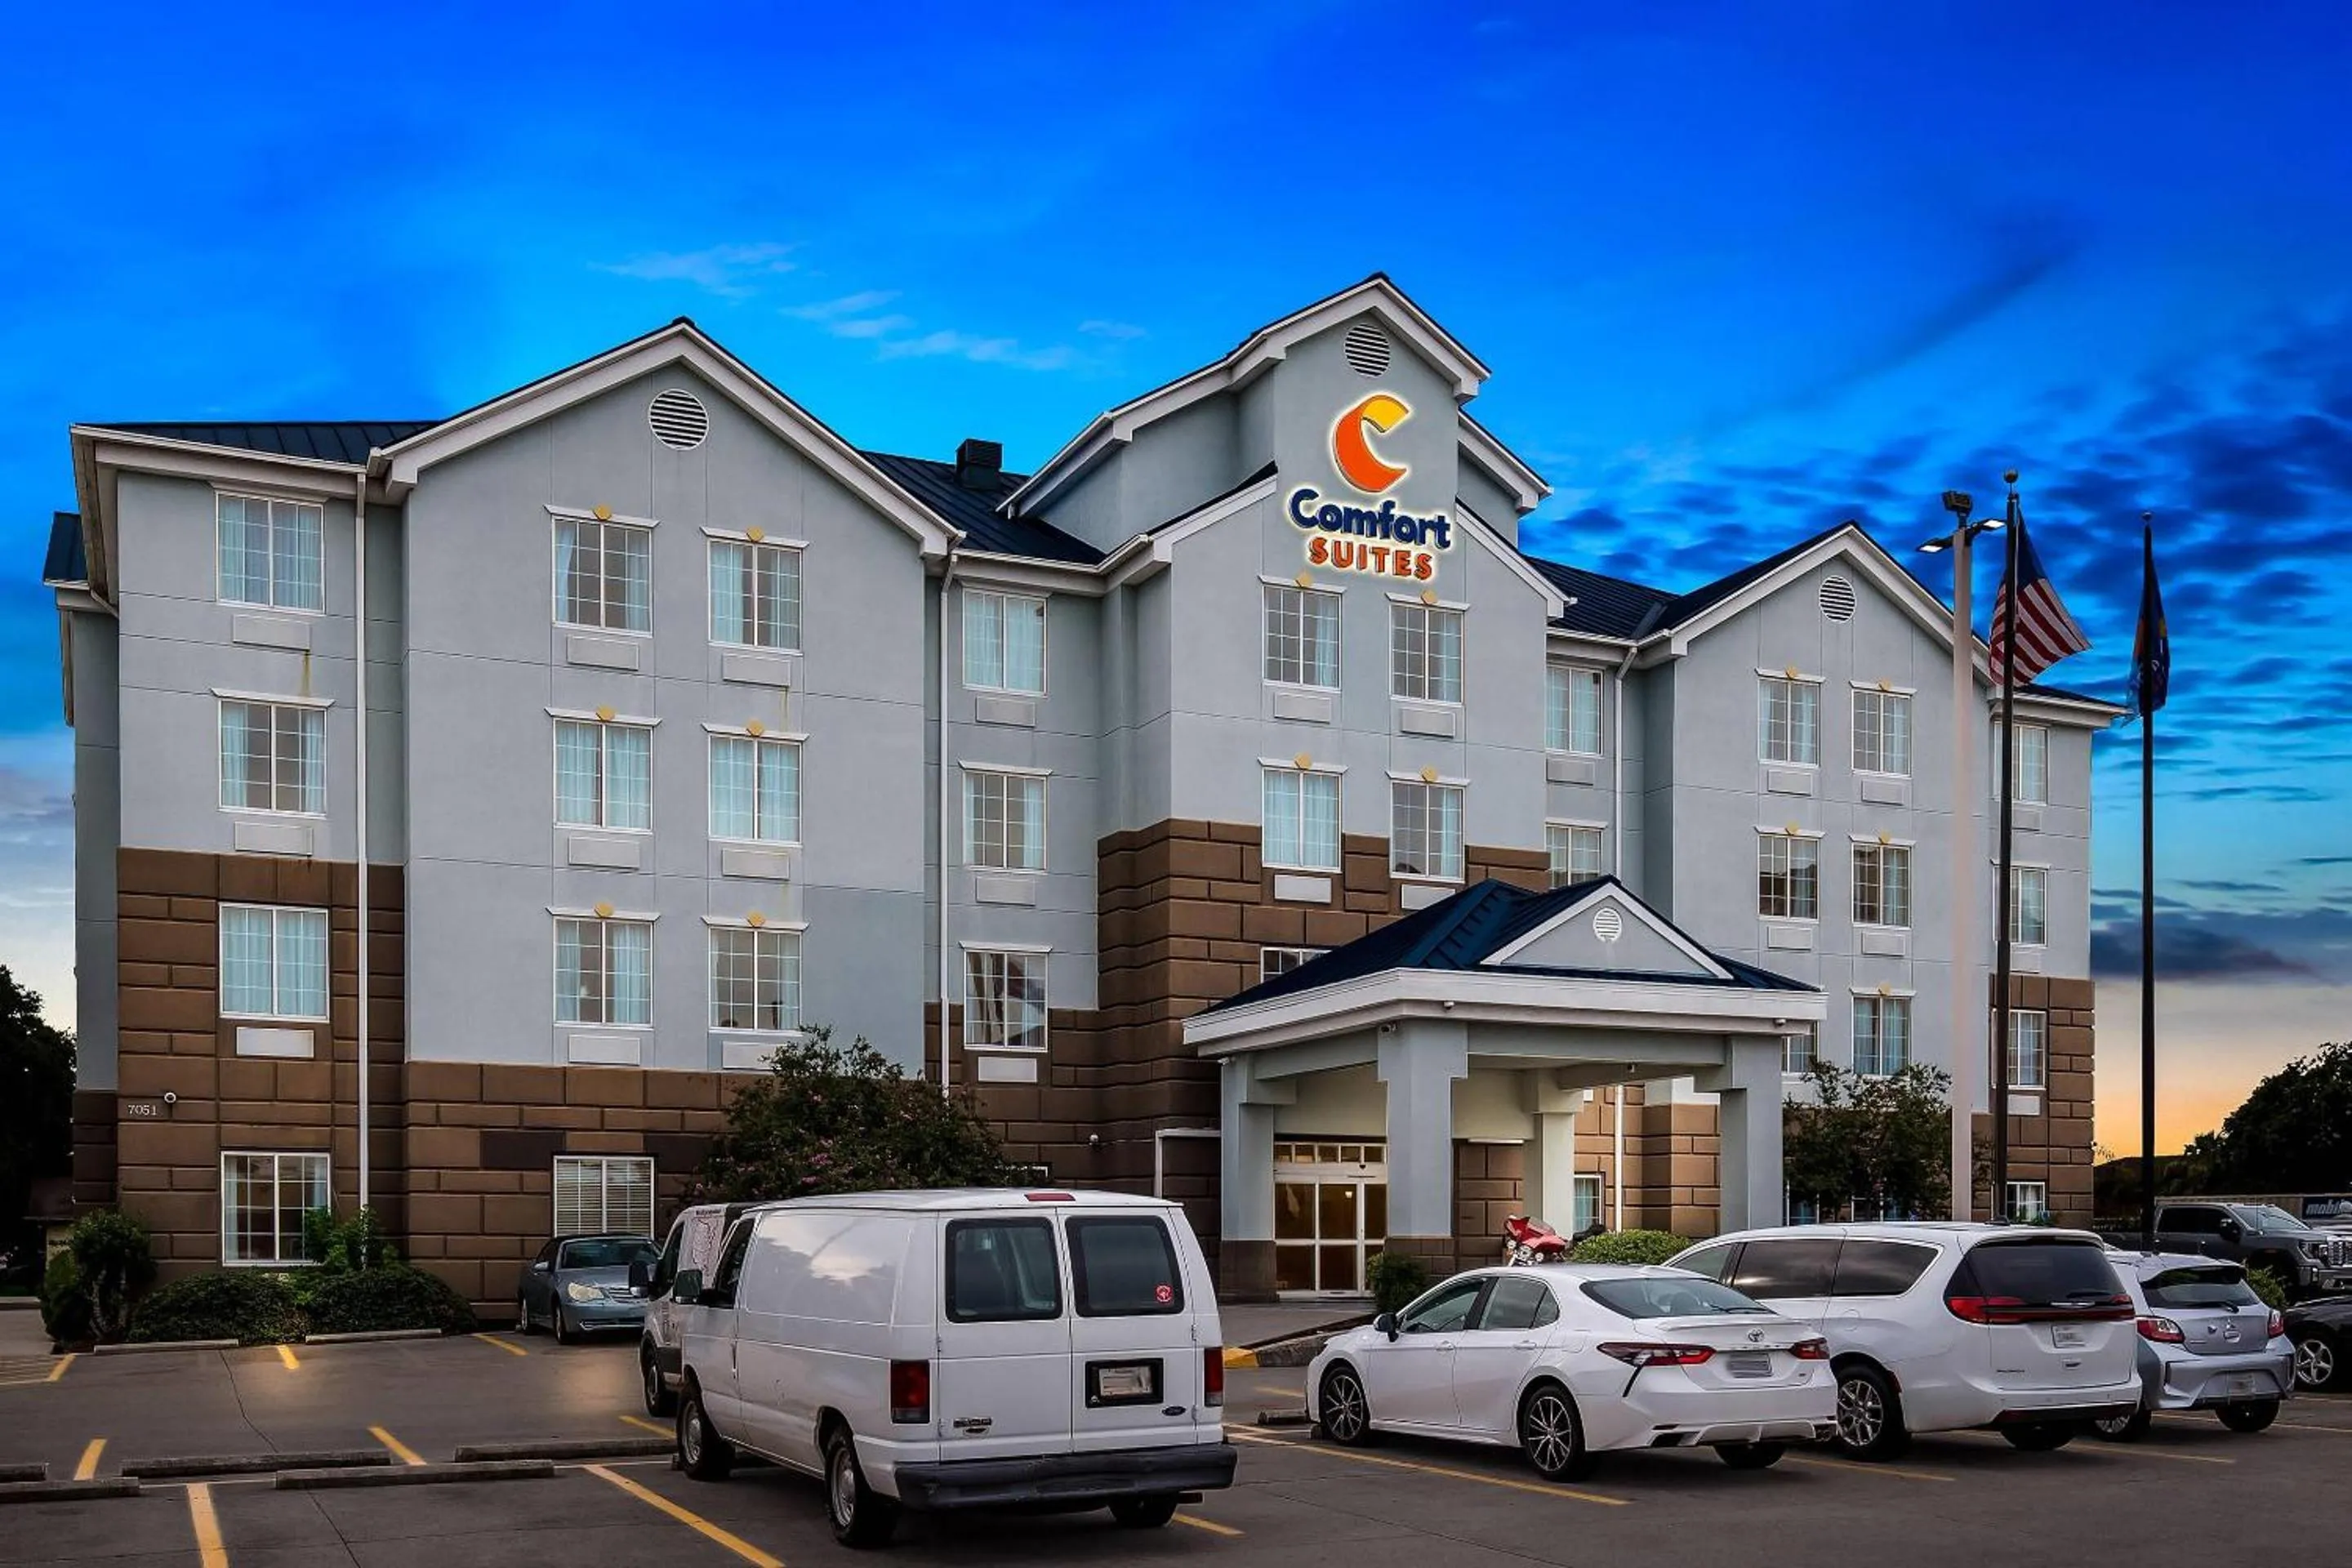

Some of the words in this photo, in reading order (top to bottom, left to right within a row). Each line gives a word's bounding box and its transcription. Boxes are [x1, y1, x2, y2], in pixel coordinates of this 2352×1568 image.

[1289, 488, 1451, 549] Comfort
[1308, 537, 1433, 581] SUITES
[127, 1104, 157, 1116] 7051
